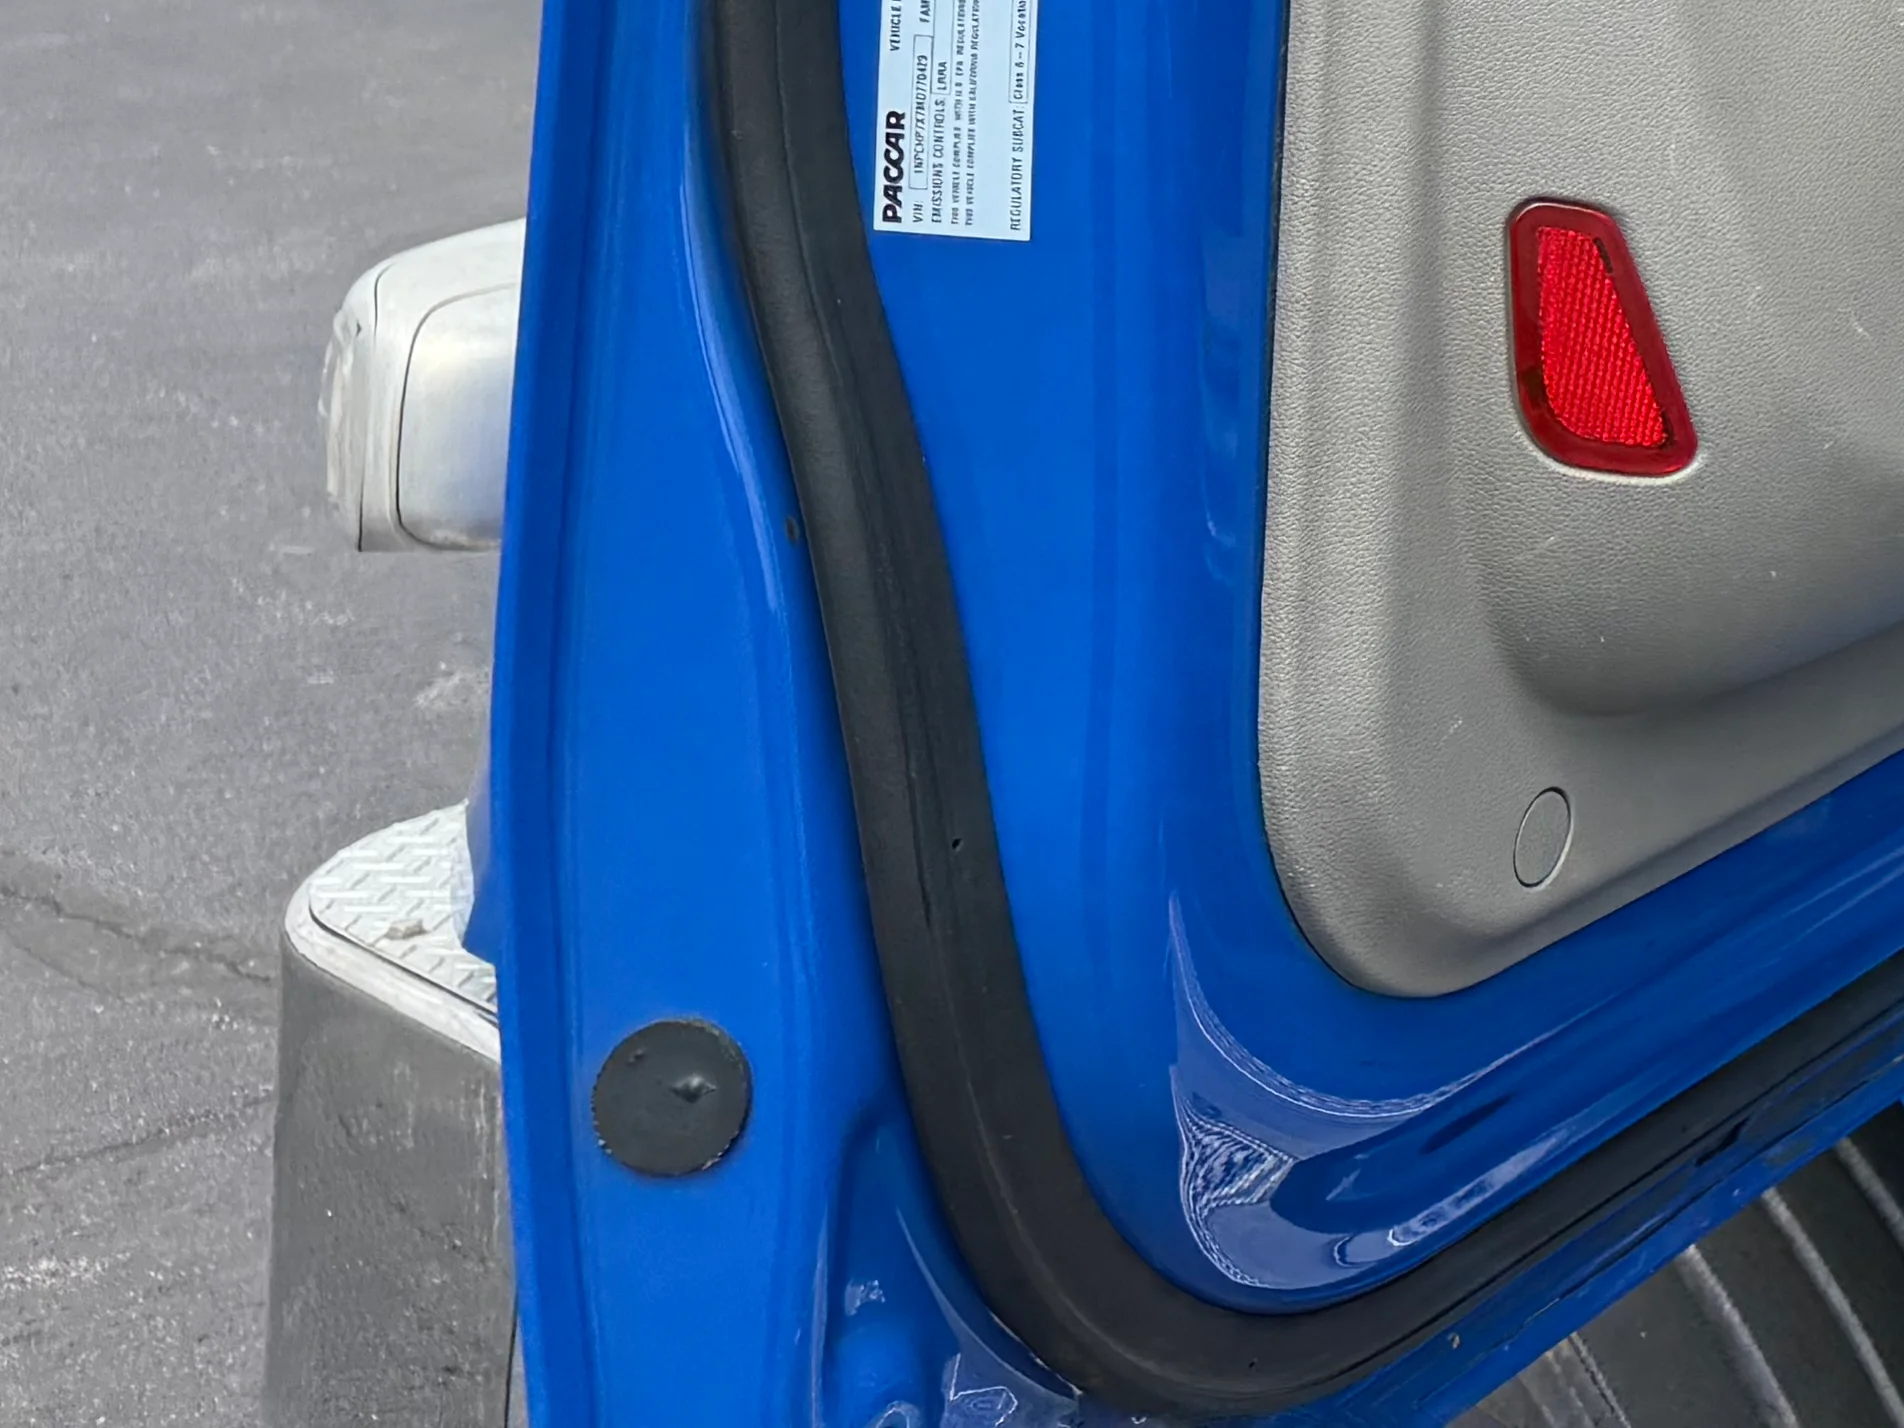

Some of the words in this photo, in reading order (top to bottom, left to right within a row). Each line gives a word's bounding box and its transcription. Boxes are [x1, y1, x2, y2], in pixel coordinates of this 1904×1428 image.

[889, 6, 901, 52] VEHICLE
[1014, 73, 1024, 100] Class
[882, 110, 906, 224] PACCAR
[931, 163, 944, 223] EMISSIONS
[912, 200, 924, 223] VIN:
[1009, 157, 1023, 231] REGULATORY
